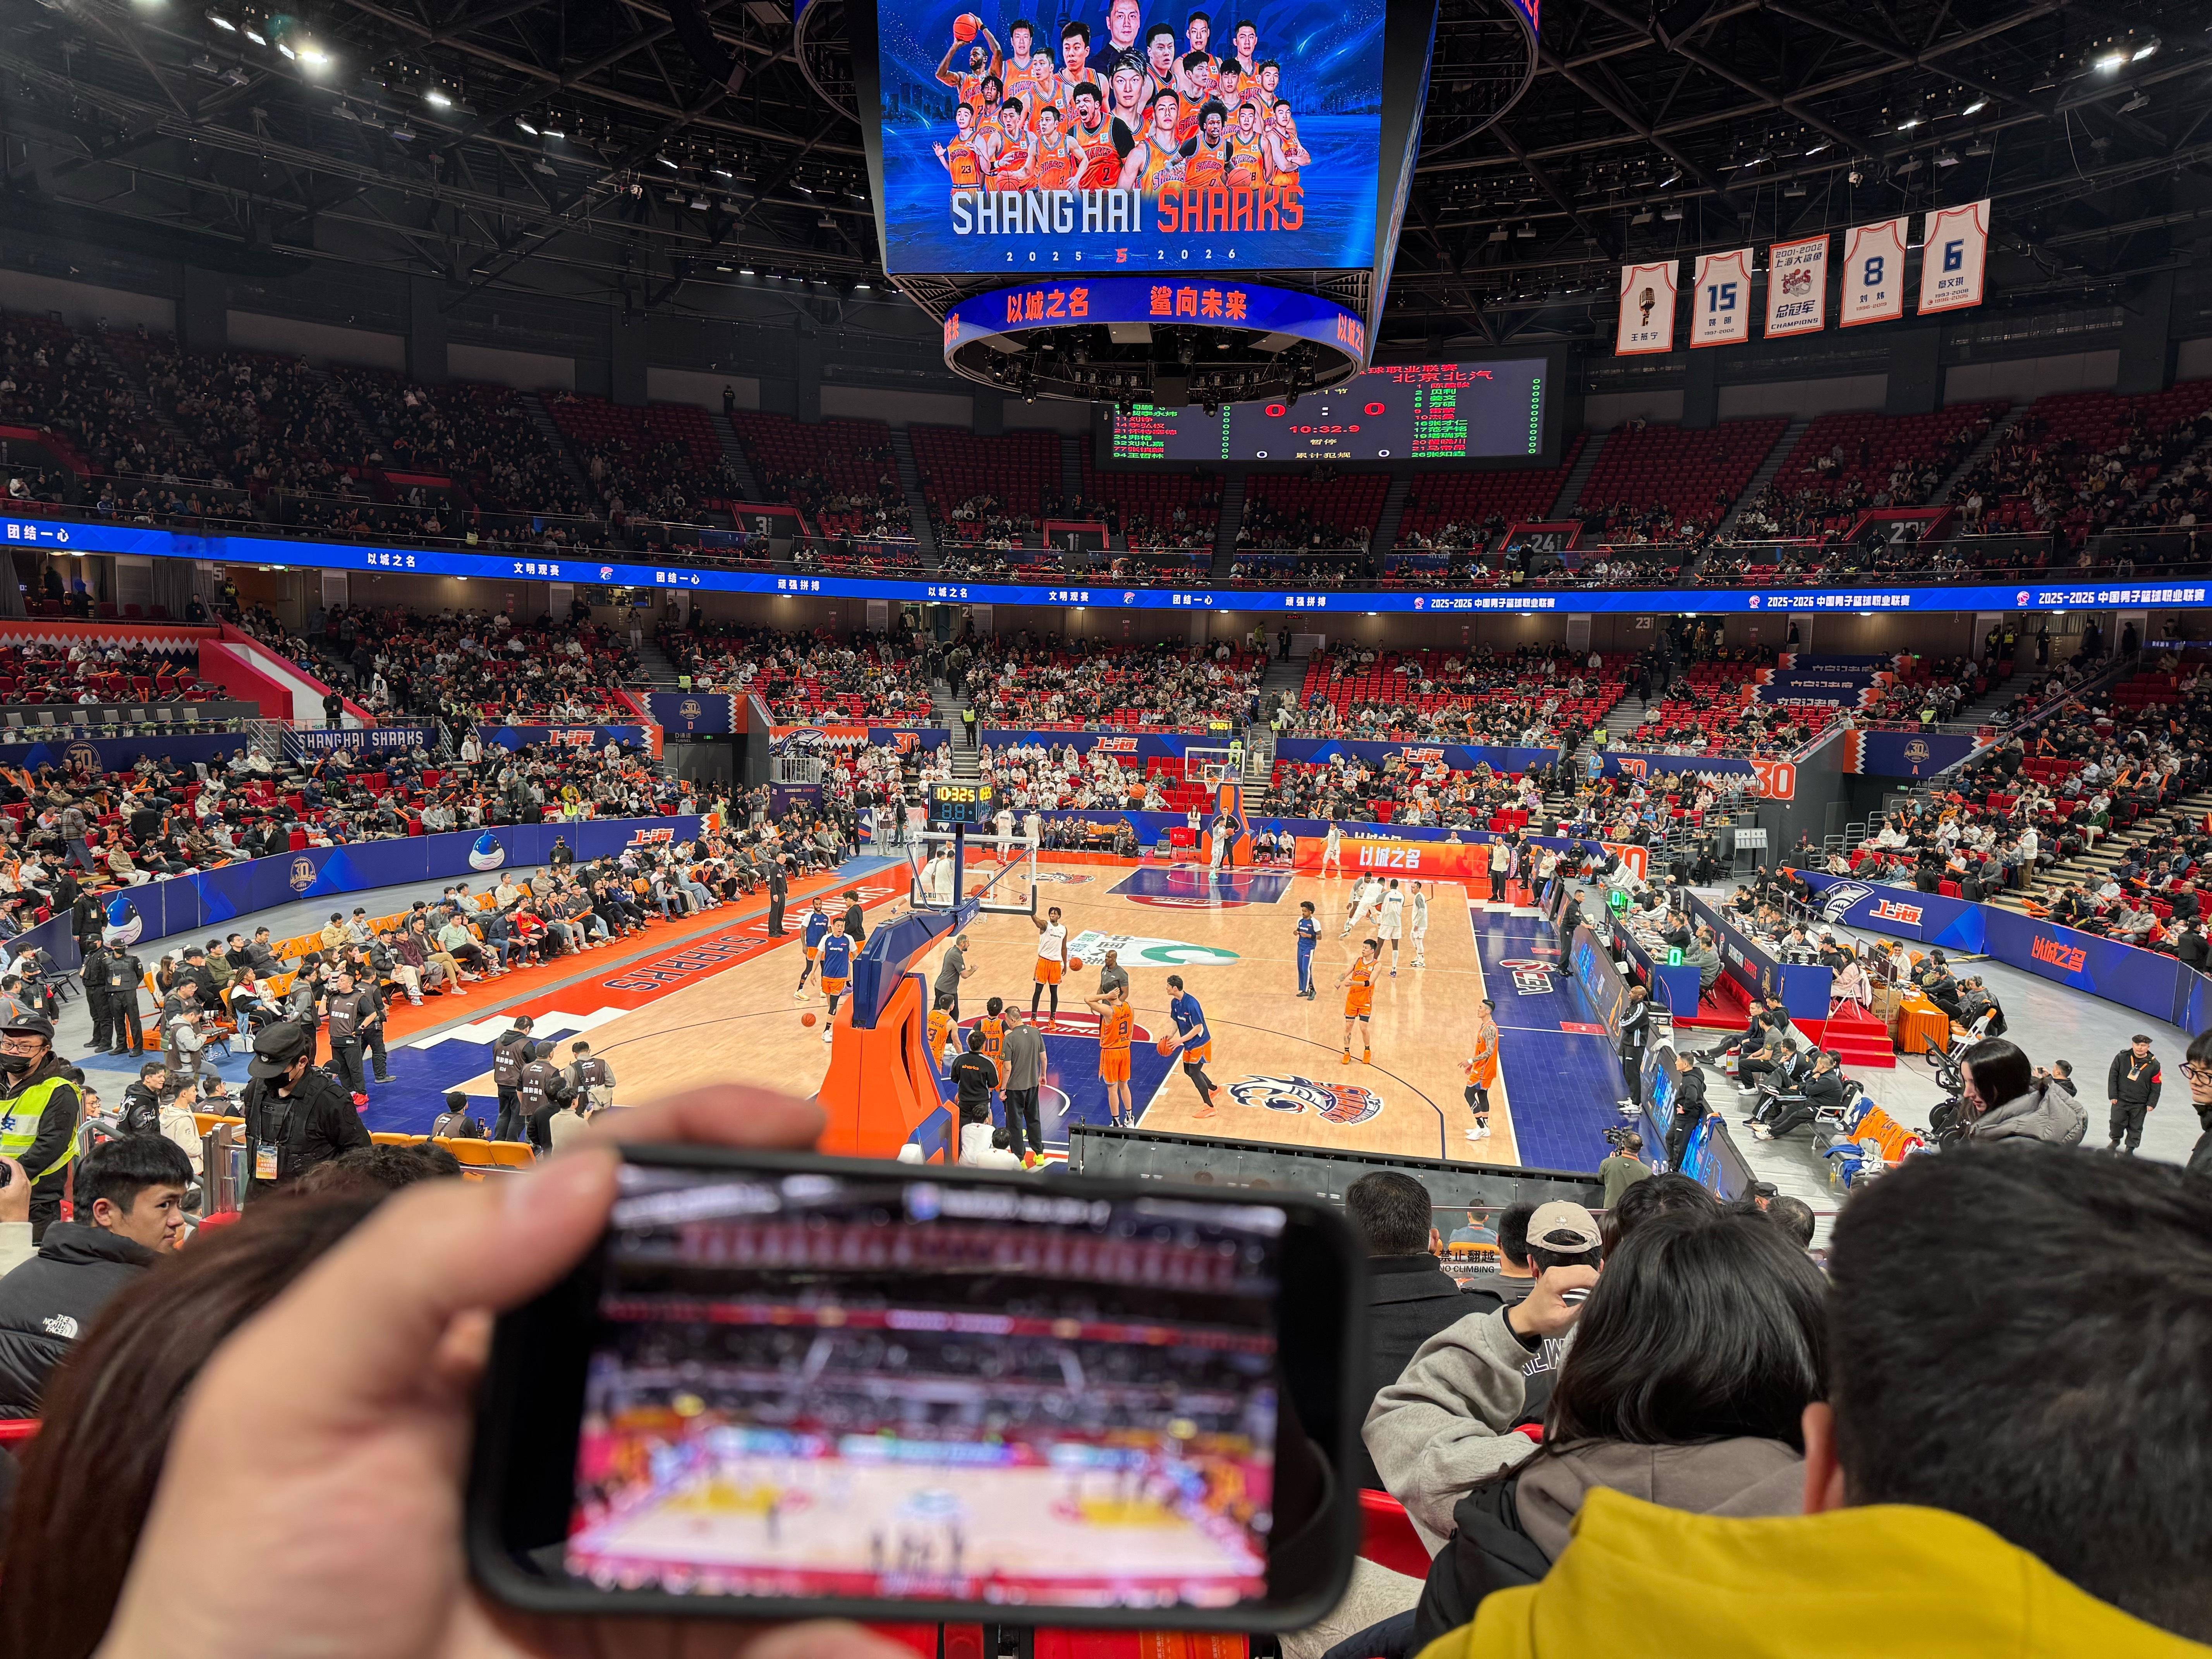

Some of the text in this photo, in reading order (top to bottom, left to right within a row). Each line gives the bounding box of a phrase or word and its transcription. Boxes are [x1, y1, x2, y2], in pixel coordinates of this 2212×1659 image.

[962, 165, 971, 174] 23
[1103, 167, 1110, 182] 2
[1158, 185, 1304, 233] SHARKS
[1006, 248, 1236, 263] 2025 2026
[1776, 243, 1823, 258] 2001-2002
[1943, 239, 1964, 273] 6
[1863, 256, 1884, 287] 8
[1007, 287, 1089, 323] 以城之名
[1150, 285, 1247, 320] 鲨向未来
[1707, 282, 1737, 313] 15
[1775, 301, 1815, 319] 总冠军
[1771, 317, 1819, 330] CHAMPIONS
[1360, 364, 1458, 375] 球职业联赛
[1393, 370, 1494, 383] 北京北汽
[1265, 402, 1385, 417] 0 0
[1289, 425, 1360, 433] 10:32.9
[8, 524, 69, 543] 团结一心
[756, 516, 768, 536] 3
[1531, 534, 1554, 553] 24
[368, 553, 415, 568] 以城之名
[514, 562, 560, 576] 文明观赛
[656, 571, 700, 585] 团结一心
[778, 579, 820, 591] 顽强拼搏
[928, 586, 968, 598] 以城之名
[1049, 591, 1089, 602] 文明观赛
[1173, 594, 1213, 605] 团结一心
[2039, 589, 2205, 605] 2025-2026 中国男子篮球职业联赛
[1431, 597, 1555, 610] 2025-2026 中国男子篮球职业联赛
[1767, 594, 1910, 608] 2025-2026 中国男子篮球职业联赛
[962, 606, 969, 618] 2
[1635, 617, 1651, 629] 23
[688, 721, 694, 730] D
[299, 730, 423, 750] SHANGHAI SHARKS
[548, 729, 596, 747] 上海
[1093, 737, 1139, 753] 上海
[1400, 747, 1445, 764] 上海
[1750, 761, 1796, 800] 30
[627, 828, 675, 846] 上海
[1360, 846, 1421, 868] 以城之名
[293, 862, 310, 878] 30
[1869, 898, 1923, 927] 上海
[2031, 935, 2087, 973] 以城之名
[602, 935, 769, 992] SHARKS
[1119, 1021, 1128, 1035] 9
[1438, 1249, 1495, 1264] 禁止翻越
[1453, 1264, 1495, 1274] CLIMBING
[43, 1317, 67, 1329] NORTH
[57, 1314, 70, 1323] THE
[45, 1325, 65, 1335] FACE
